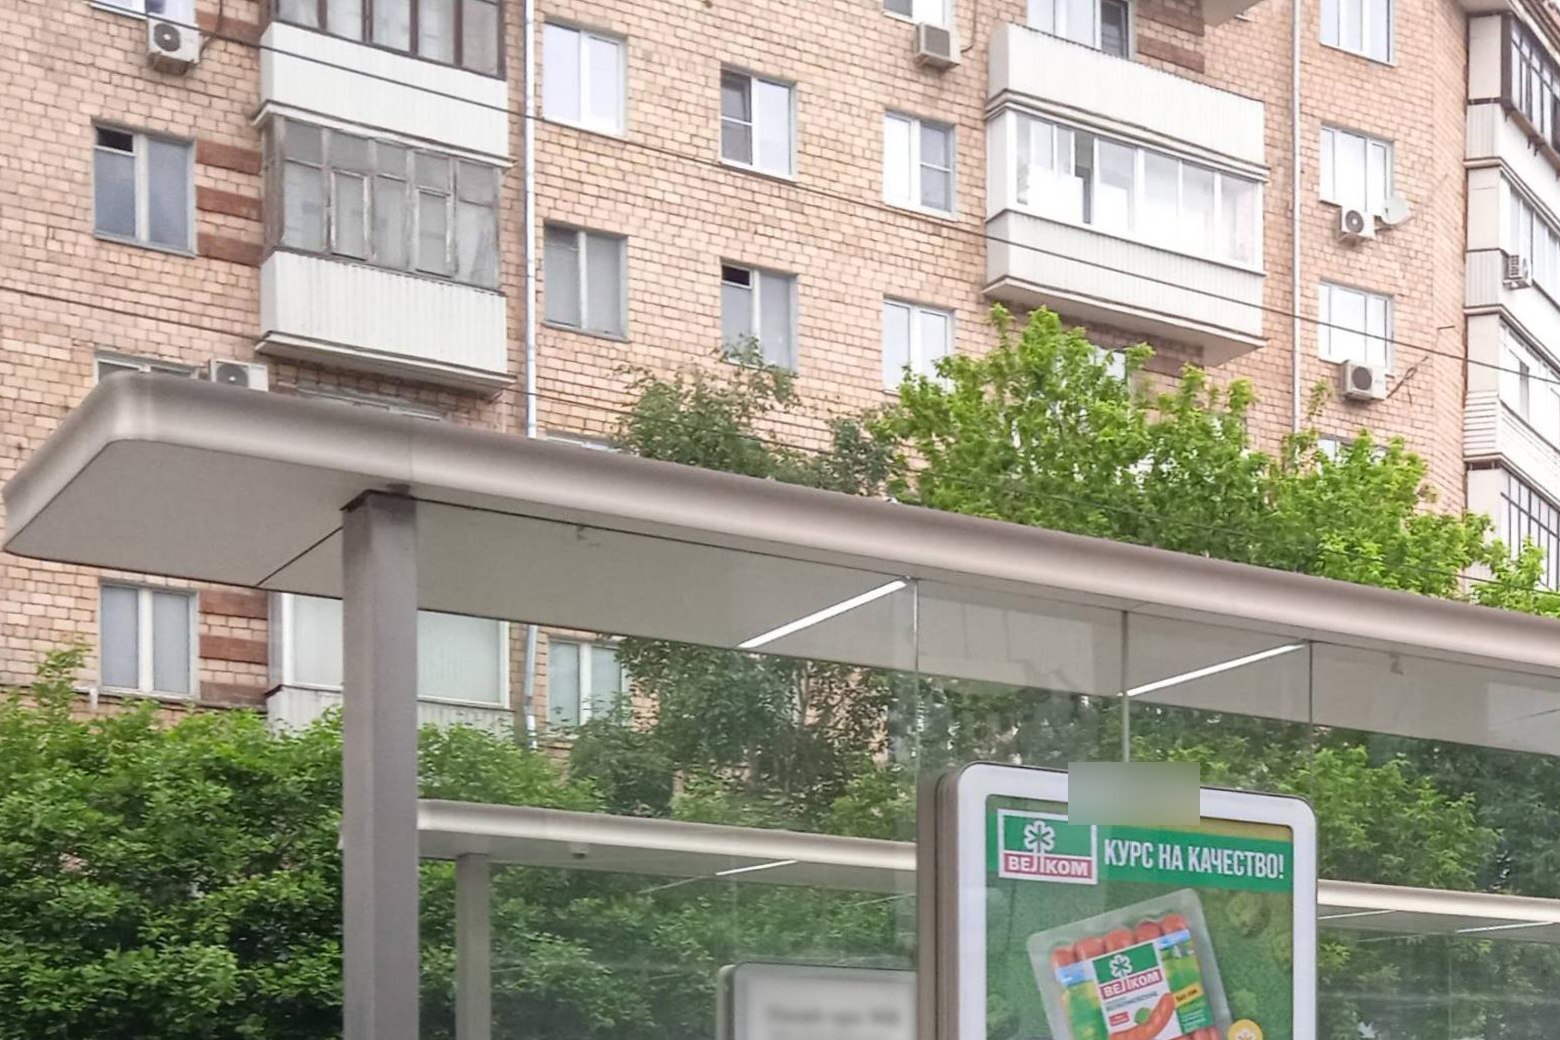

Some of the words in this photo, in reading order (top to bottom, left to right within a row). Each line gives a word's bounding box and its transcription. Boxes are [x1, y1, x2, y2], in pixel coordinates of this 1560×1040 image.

[1104, 839, 1153, 868] КУРС
[1159, 843, 1183, 871] НА
[1188, 846, 1284, 879] КАЧЕСТВО!
